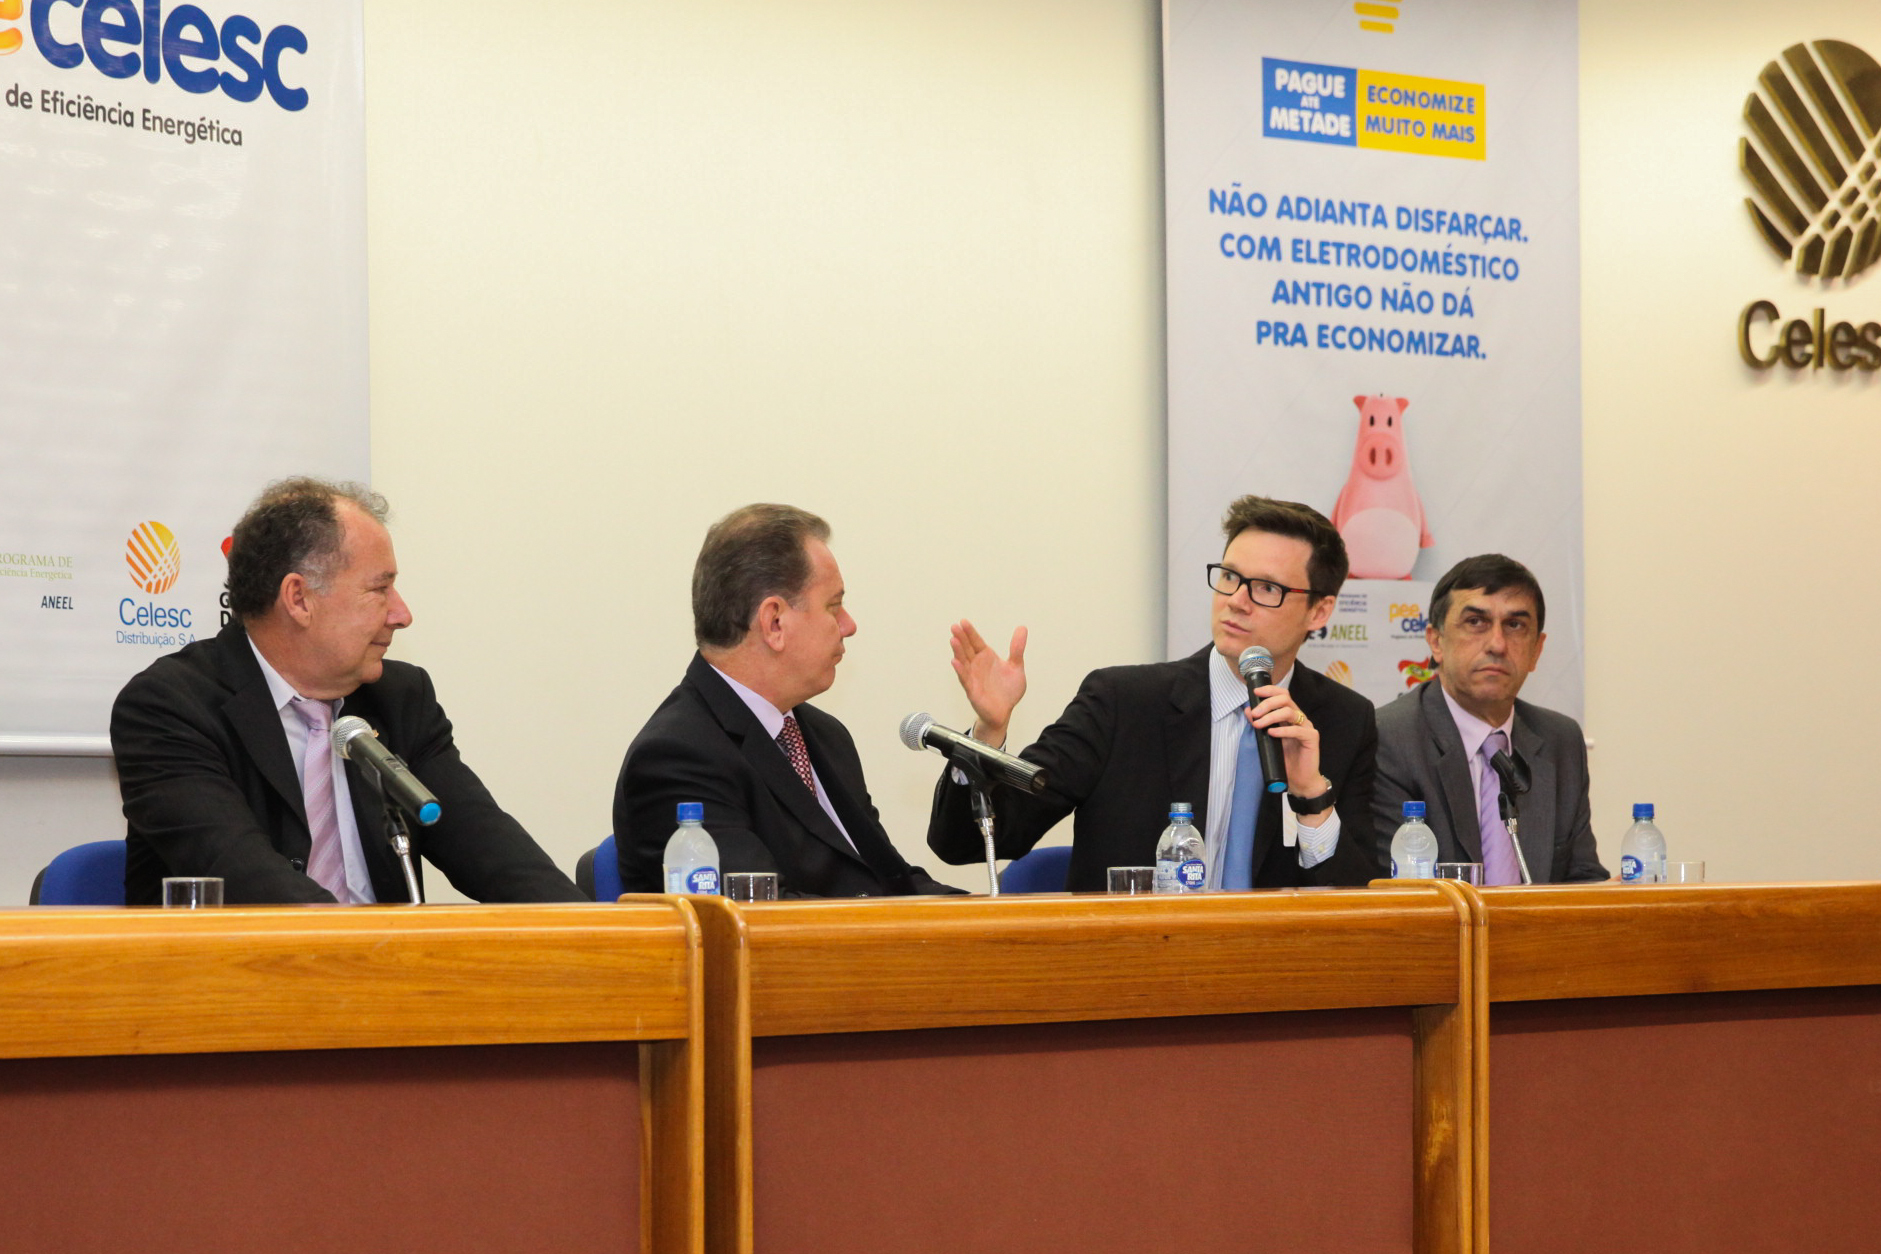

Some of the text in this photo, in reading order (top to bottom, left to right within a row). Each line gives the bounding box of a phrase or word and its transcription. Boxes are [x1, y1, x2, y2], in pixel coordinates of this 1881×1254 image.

[31, 0, 309, 112] celesc
[1274, 68, 1346, 98] PAGUE
[5, 83, 244, 147] de Eficiência Energética
[1367, 84, 1476, 115] ECONOMIZE
[1269, 107, 1351, 137] METADE
[1365, 114, 1476, 144] MUITO MAIS
[1208, 182, 1529, 245] NÃO ADIANTA DISFARÇAR.
[1219, 232, 1520, 282] COM ELETRODOMÉSTICO
[1271, 278, 1475, 319] ANTIGO NÃO DÁ
[1256, 320, 1487, 360] PRA ECONOMIZAR.
[1738, 299, 1881, 371] Celes
[58, 555, 74, 568] DE
[40, 595, 74, 610] ANEEL
[119, 597, 192, 629] Celesc
[116, 630, 176, 648] Distribuição
[1330, 624, 1369, 641] ANEEL
[692, 873, 717, 882] SANTA
